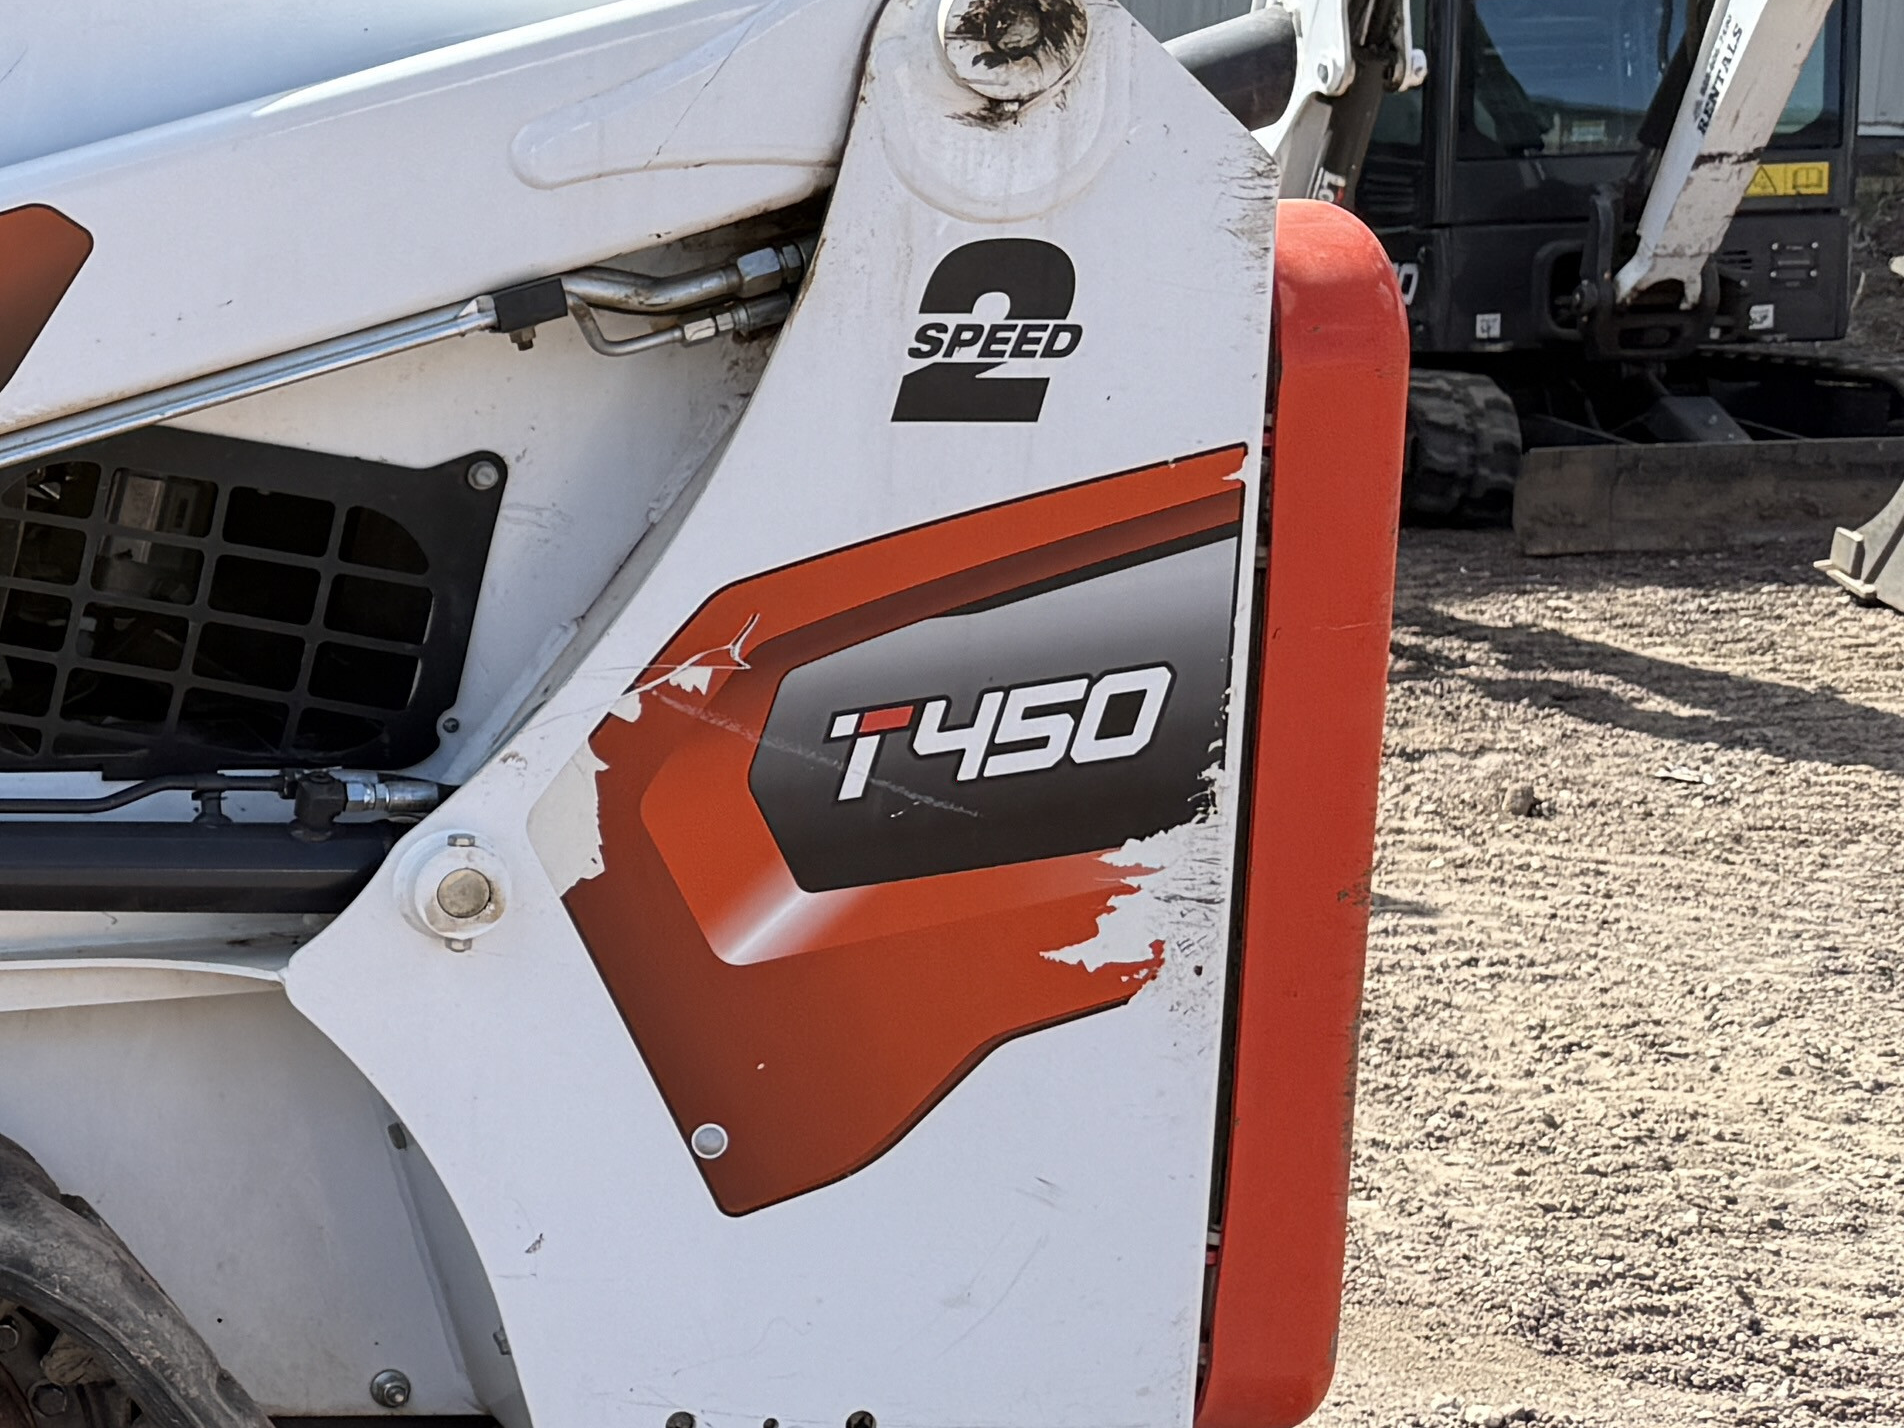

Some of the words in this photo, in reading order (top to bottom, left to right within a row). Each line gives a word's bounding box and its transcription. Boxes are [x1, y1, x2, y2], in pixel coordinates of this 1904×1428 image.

[1696, 22, 1744, 135] RENTALS
[891, 238, 1076, 422] 2
[908, 322, 1083, 359] SPEED
[829, 665, 1173, 802] T450
